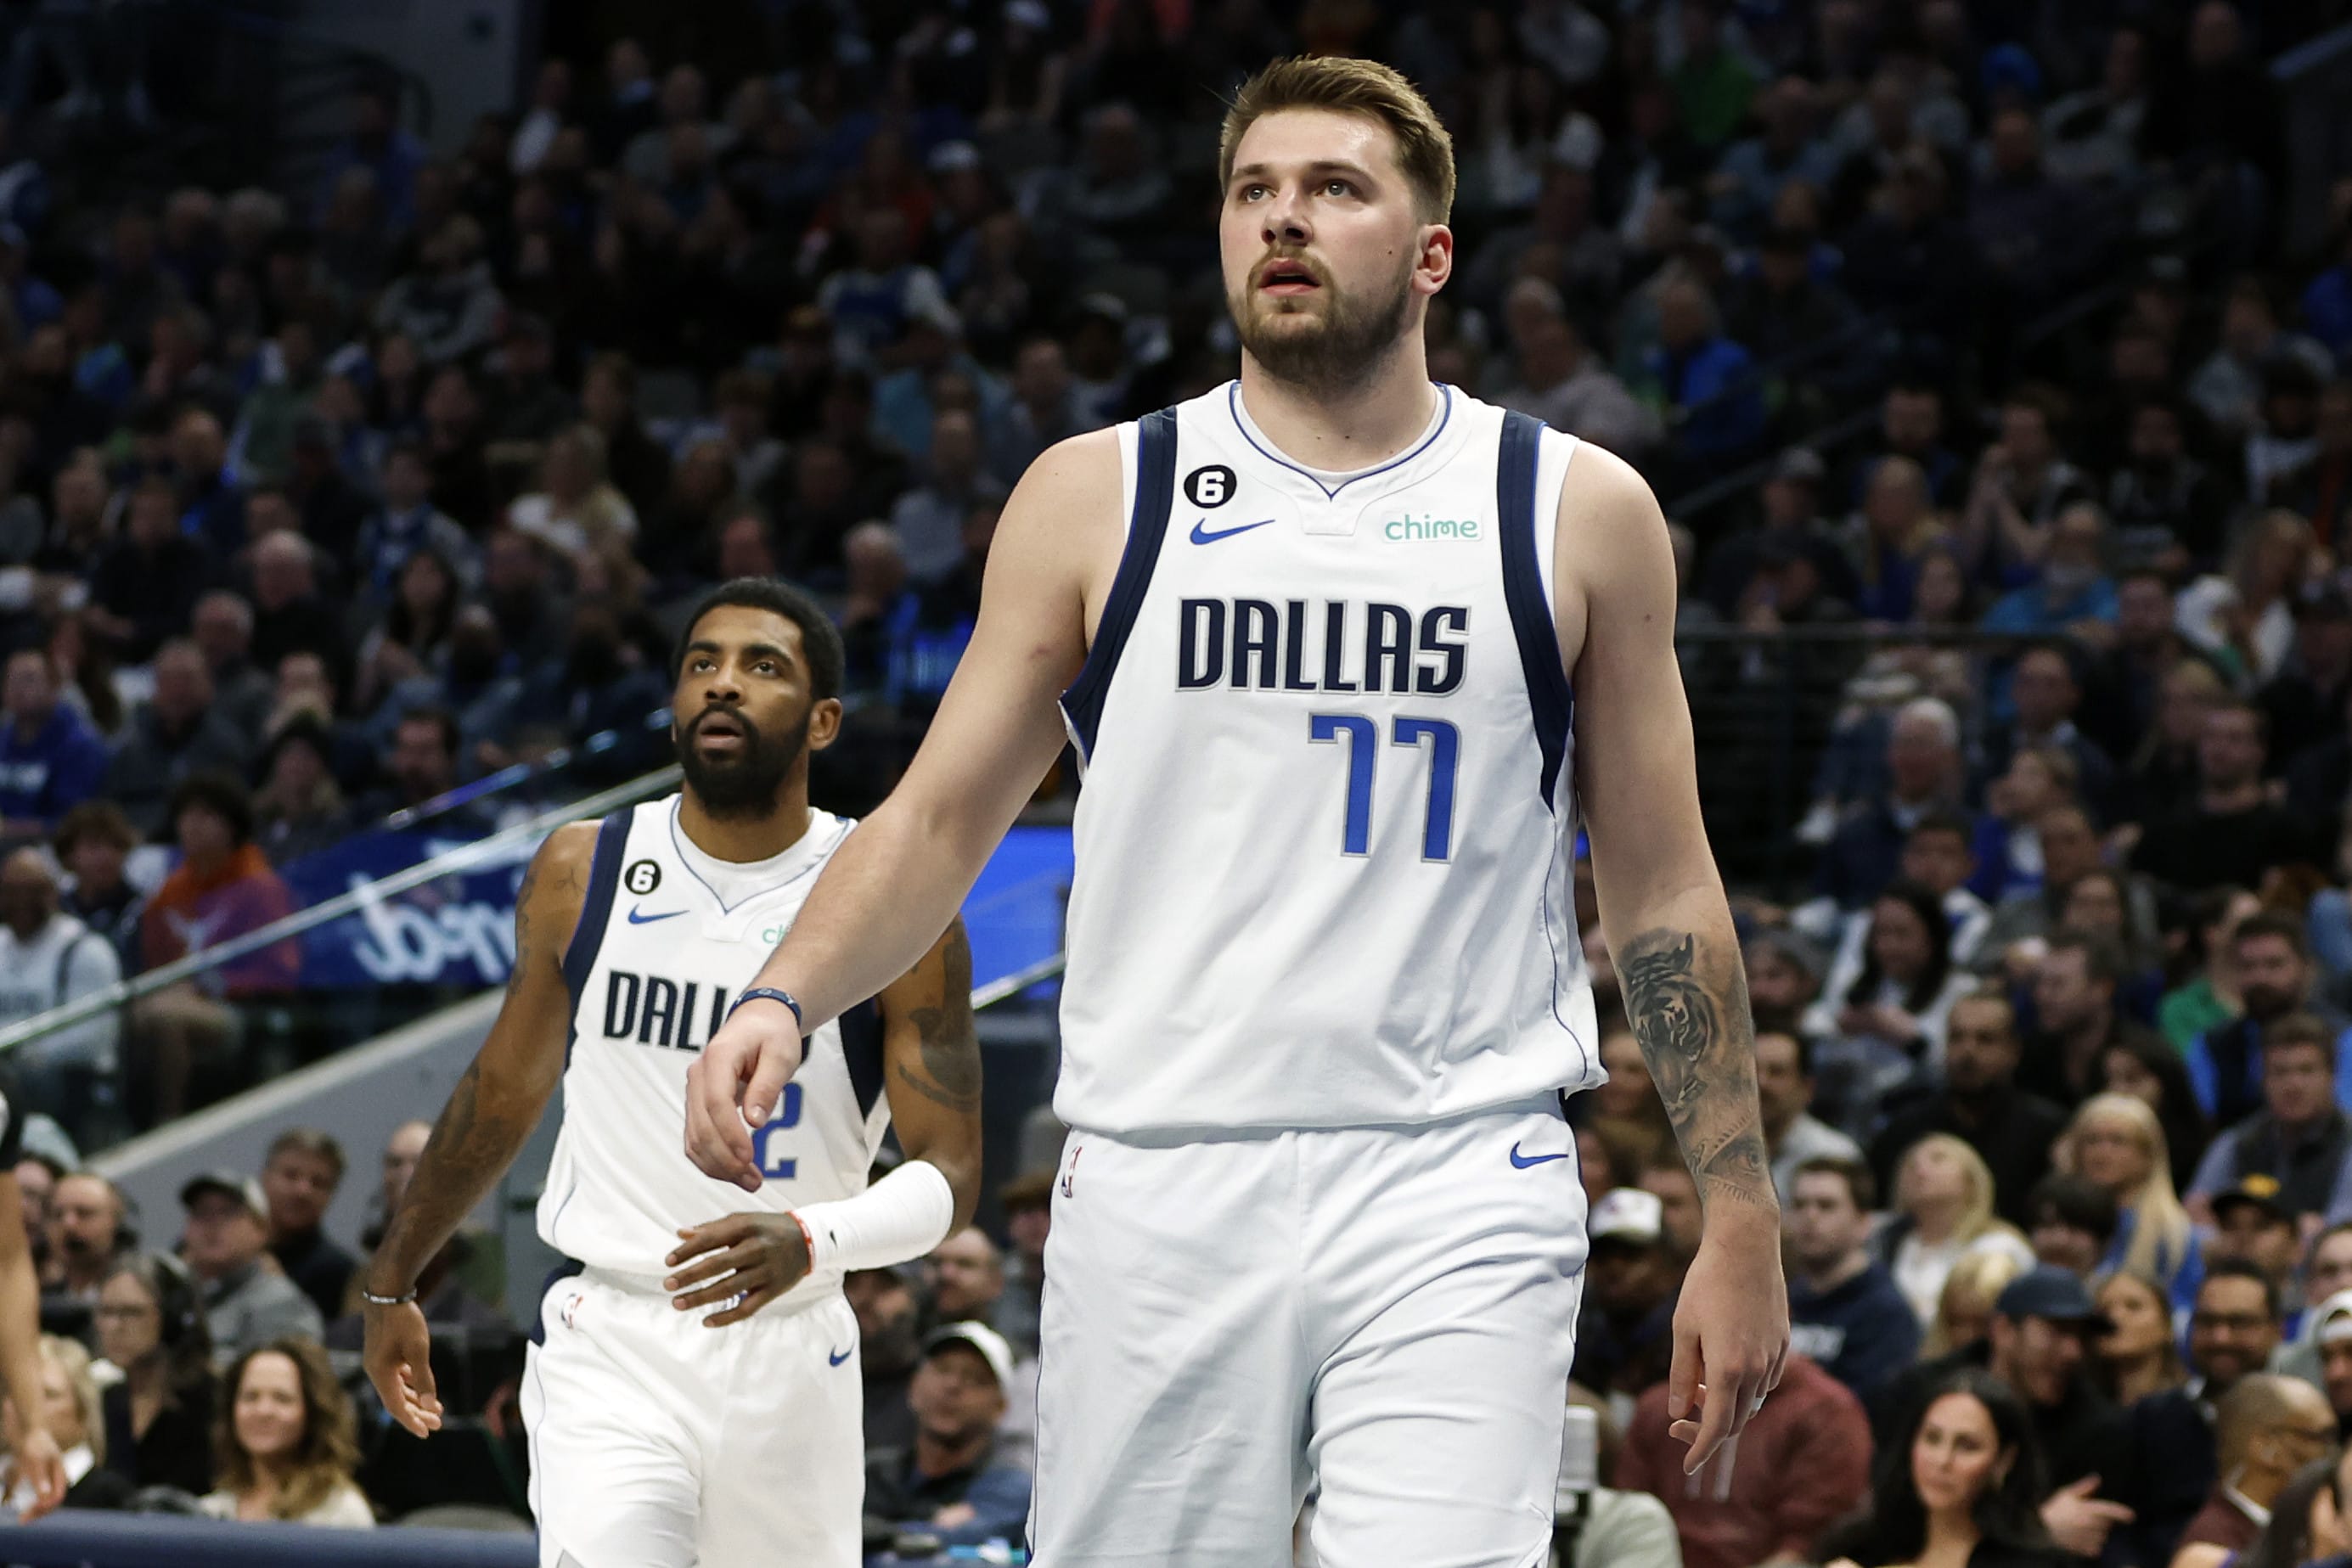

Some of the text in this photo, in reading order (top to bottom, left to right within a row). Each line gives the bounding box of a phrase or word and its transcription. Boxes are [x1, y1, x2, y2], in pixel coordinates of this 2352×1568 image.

[1196, 470, 1225, 503] 6
[1385, 514, 1478, 540] chime
[1175, 597, 1471, 698] DALLAS
[1308, 711, 1463, 864] 77
[631, 863, 656, 892] 6
[751, 1080, 804, 1180] 2
